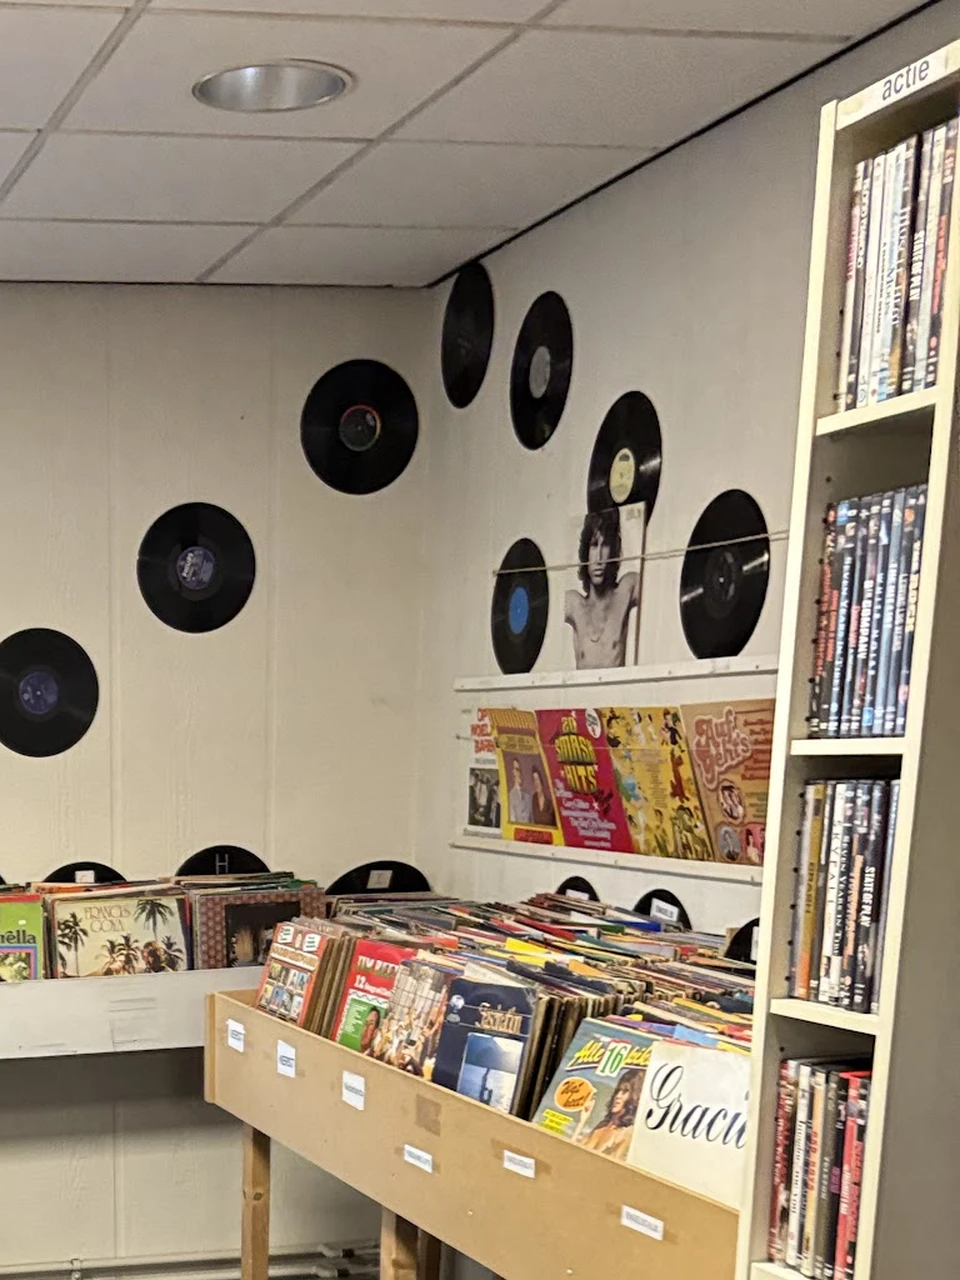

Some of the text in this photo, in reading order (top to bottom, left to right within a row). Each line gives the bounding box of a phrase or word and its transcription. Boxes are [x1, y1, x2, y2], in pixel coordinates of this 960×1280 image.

[882, 59, 930, 101] actie
[912, 230, 925, 261] STATE
[909, 276, 922, 301] PLAY
[857, 599, 872, 659] COMPANY
[553, 734, 597, 763] SMASH
[563, 763, 598, 793] HITS
[214, 853, 230, 875] H
[827, 819, 843, 903] SKYFALL
[859, 865, 876, 927] STATE OF PLAY
[83, 904, 132, 920] FRANCIS
[90, 919, 125, 934] GOYA
[600, 1044, 628, 1074] 16
